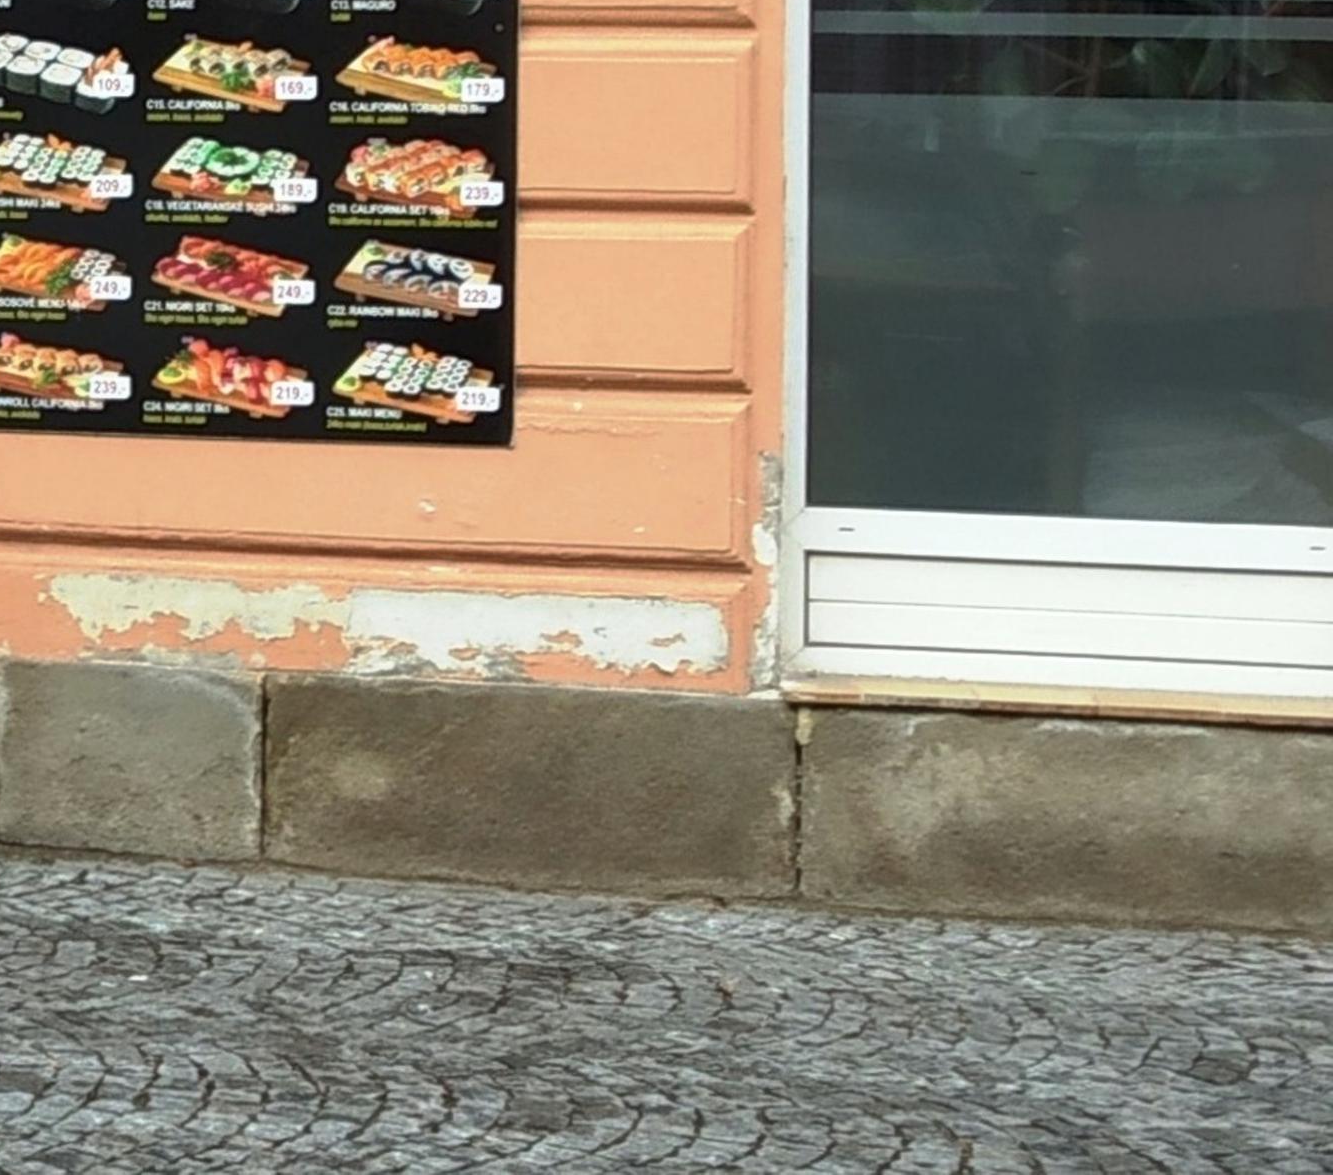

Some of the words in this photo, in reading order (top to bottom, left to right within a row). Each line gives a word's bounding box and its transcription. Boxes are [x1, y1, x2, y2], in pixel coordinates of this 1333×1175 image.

[167, 99, 224, 111] CALIFORNIA
[351, 101, 408, 113] CALIFORNIA
[350, 203, 407, 215] CALIFORNIA
